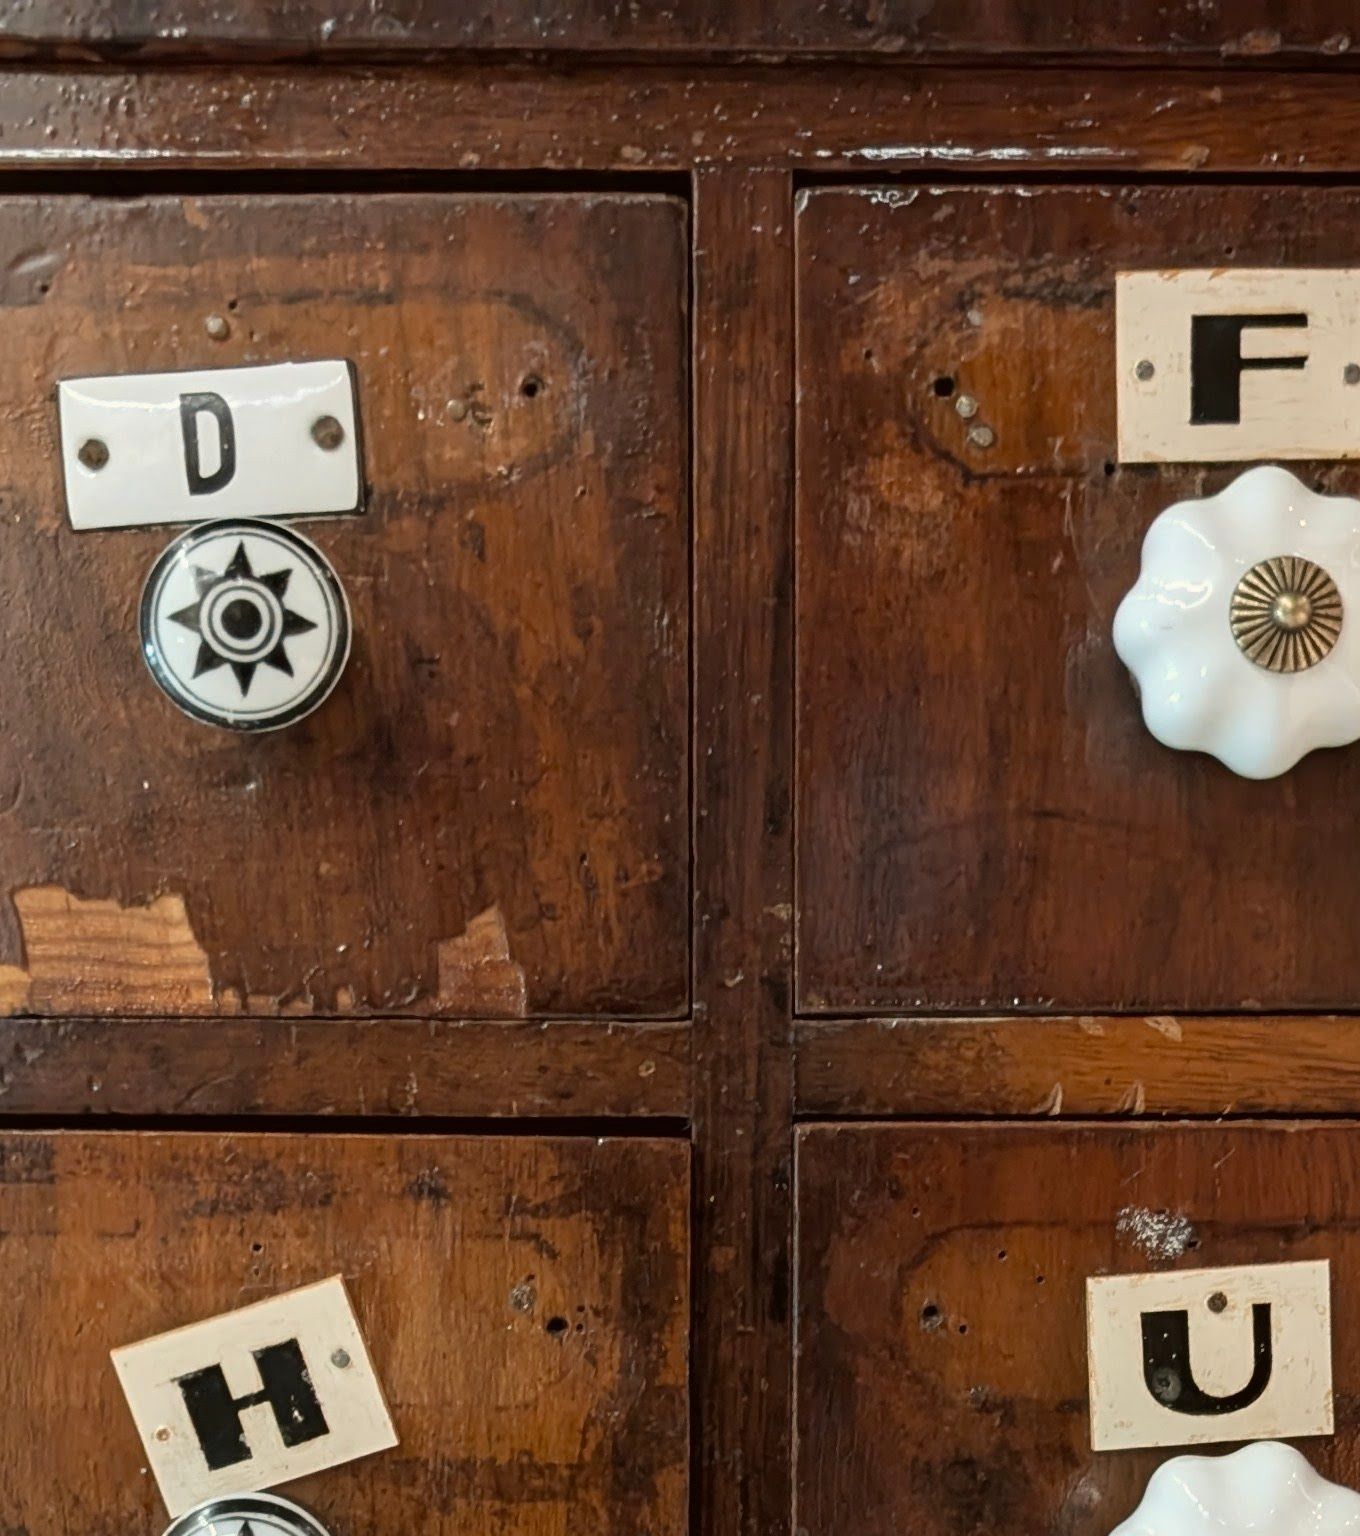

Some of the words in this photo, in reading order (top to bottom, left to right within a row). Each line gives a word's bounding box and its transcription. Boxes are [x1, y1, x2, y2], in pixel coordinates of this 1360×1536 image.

[1188, 311, 1310, 426] F
[179, 392, 237, 496] D
[176, 1337, 331, 1472] H
[1140, 1301, 1274, 1417] U
